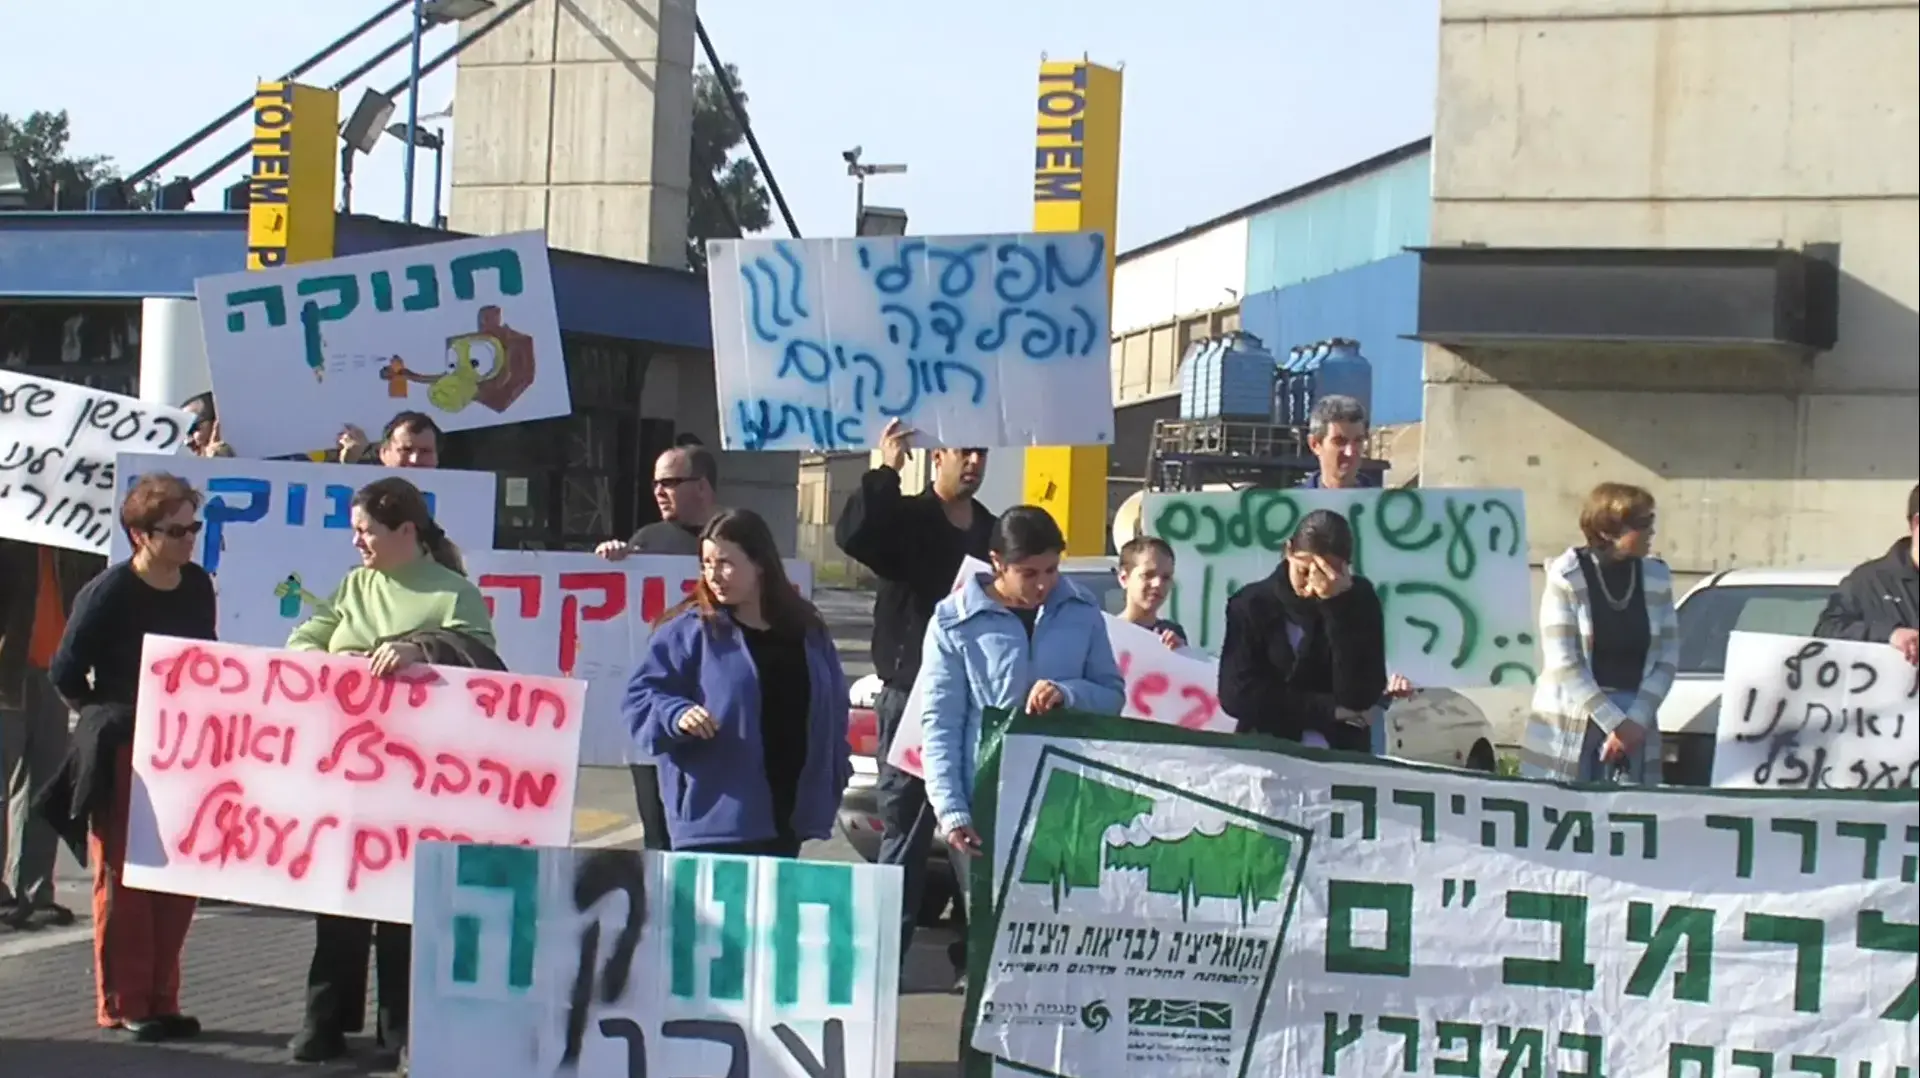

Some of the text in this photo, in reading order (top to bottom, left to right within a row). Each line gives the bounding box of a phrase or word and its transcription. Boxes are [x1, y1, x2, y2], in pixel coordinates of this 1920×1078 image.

[250, 83, 294, 203] TOTEM
[1034, 66, 1087, 202] TOTEM
[859, 231, 1106, 301] מפעלי
[226, 247, 524, 370] חנוקה
[881, 302, 1098, 359] הפלדה
[778, 338, 984, 416] חונקים
[65, 397, 180, 449] העשן
[126, 474, 437, 573] נוק
[1154, 488, 1520, 580] העשן שלכם
[478, 571, 800, 673] וקה
[150, 646, 250, 694] כסף
[1784, 641, 1878, 694] כסף
[317, 720, 558, 810] מהברזל
[1330, 784, 1657, 860] המהירה
[452, 844, 856, 1070] חנוקה
[1007, 922, 1269, 973] הקואליציה לבריאות הציבור
[1322, 1011, 1605, 1078] במפרץ
